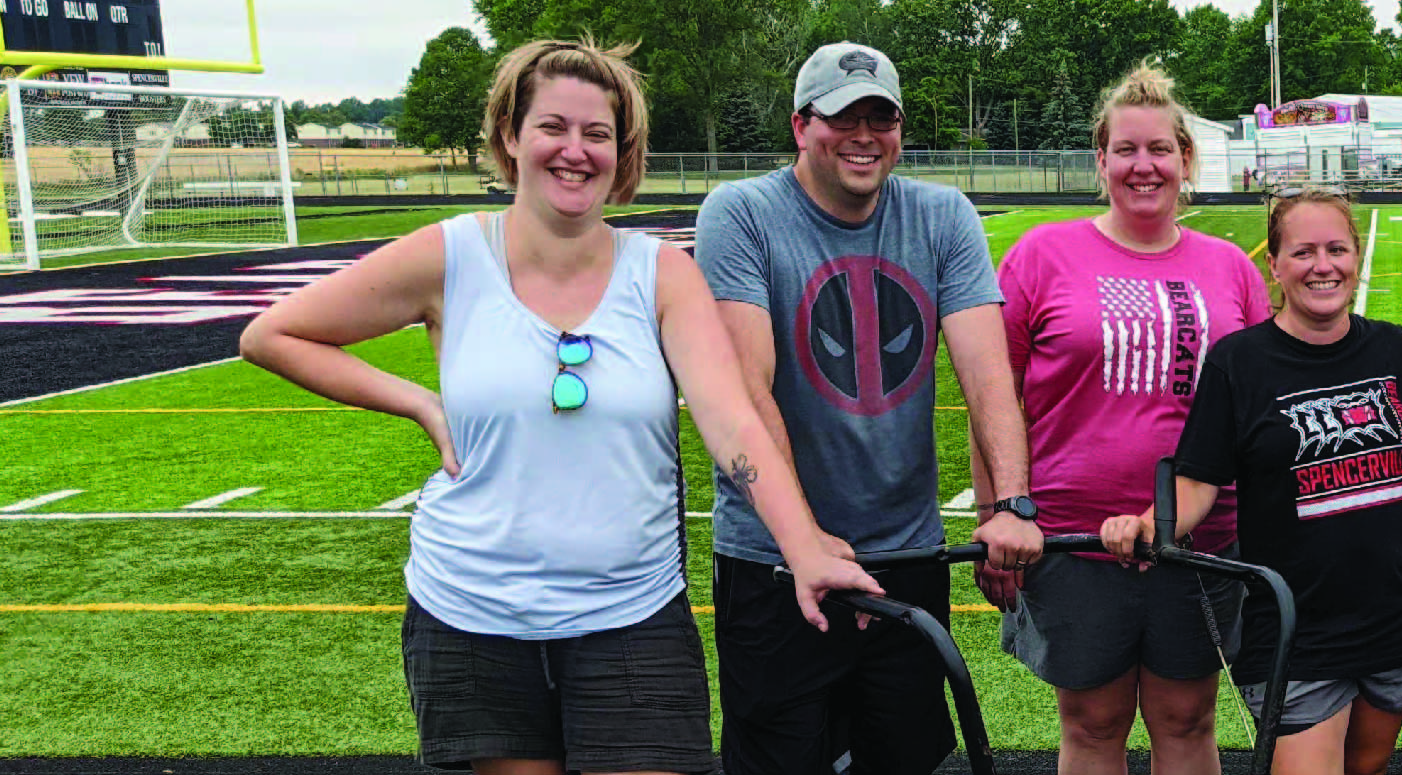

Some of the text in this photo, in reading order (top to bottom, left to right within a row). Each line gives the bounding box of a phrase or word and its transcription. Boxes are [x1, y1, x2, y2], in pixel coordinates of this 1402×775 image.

[64, 1, 98, 21] BALL ON
[110, 5, 128, 23] QTR
[1166, 281, 1196, 396] BEARCATS
